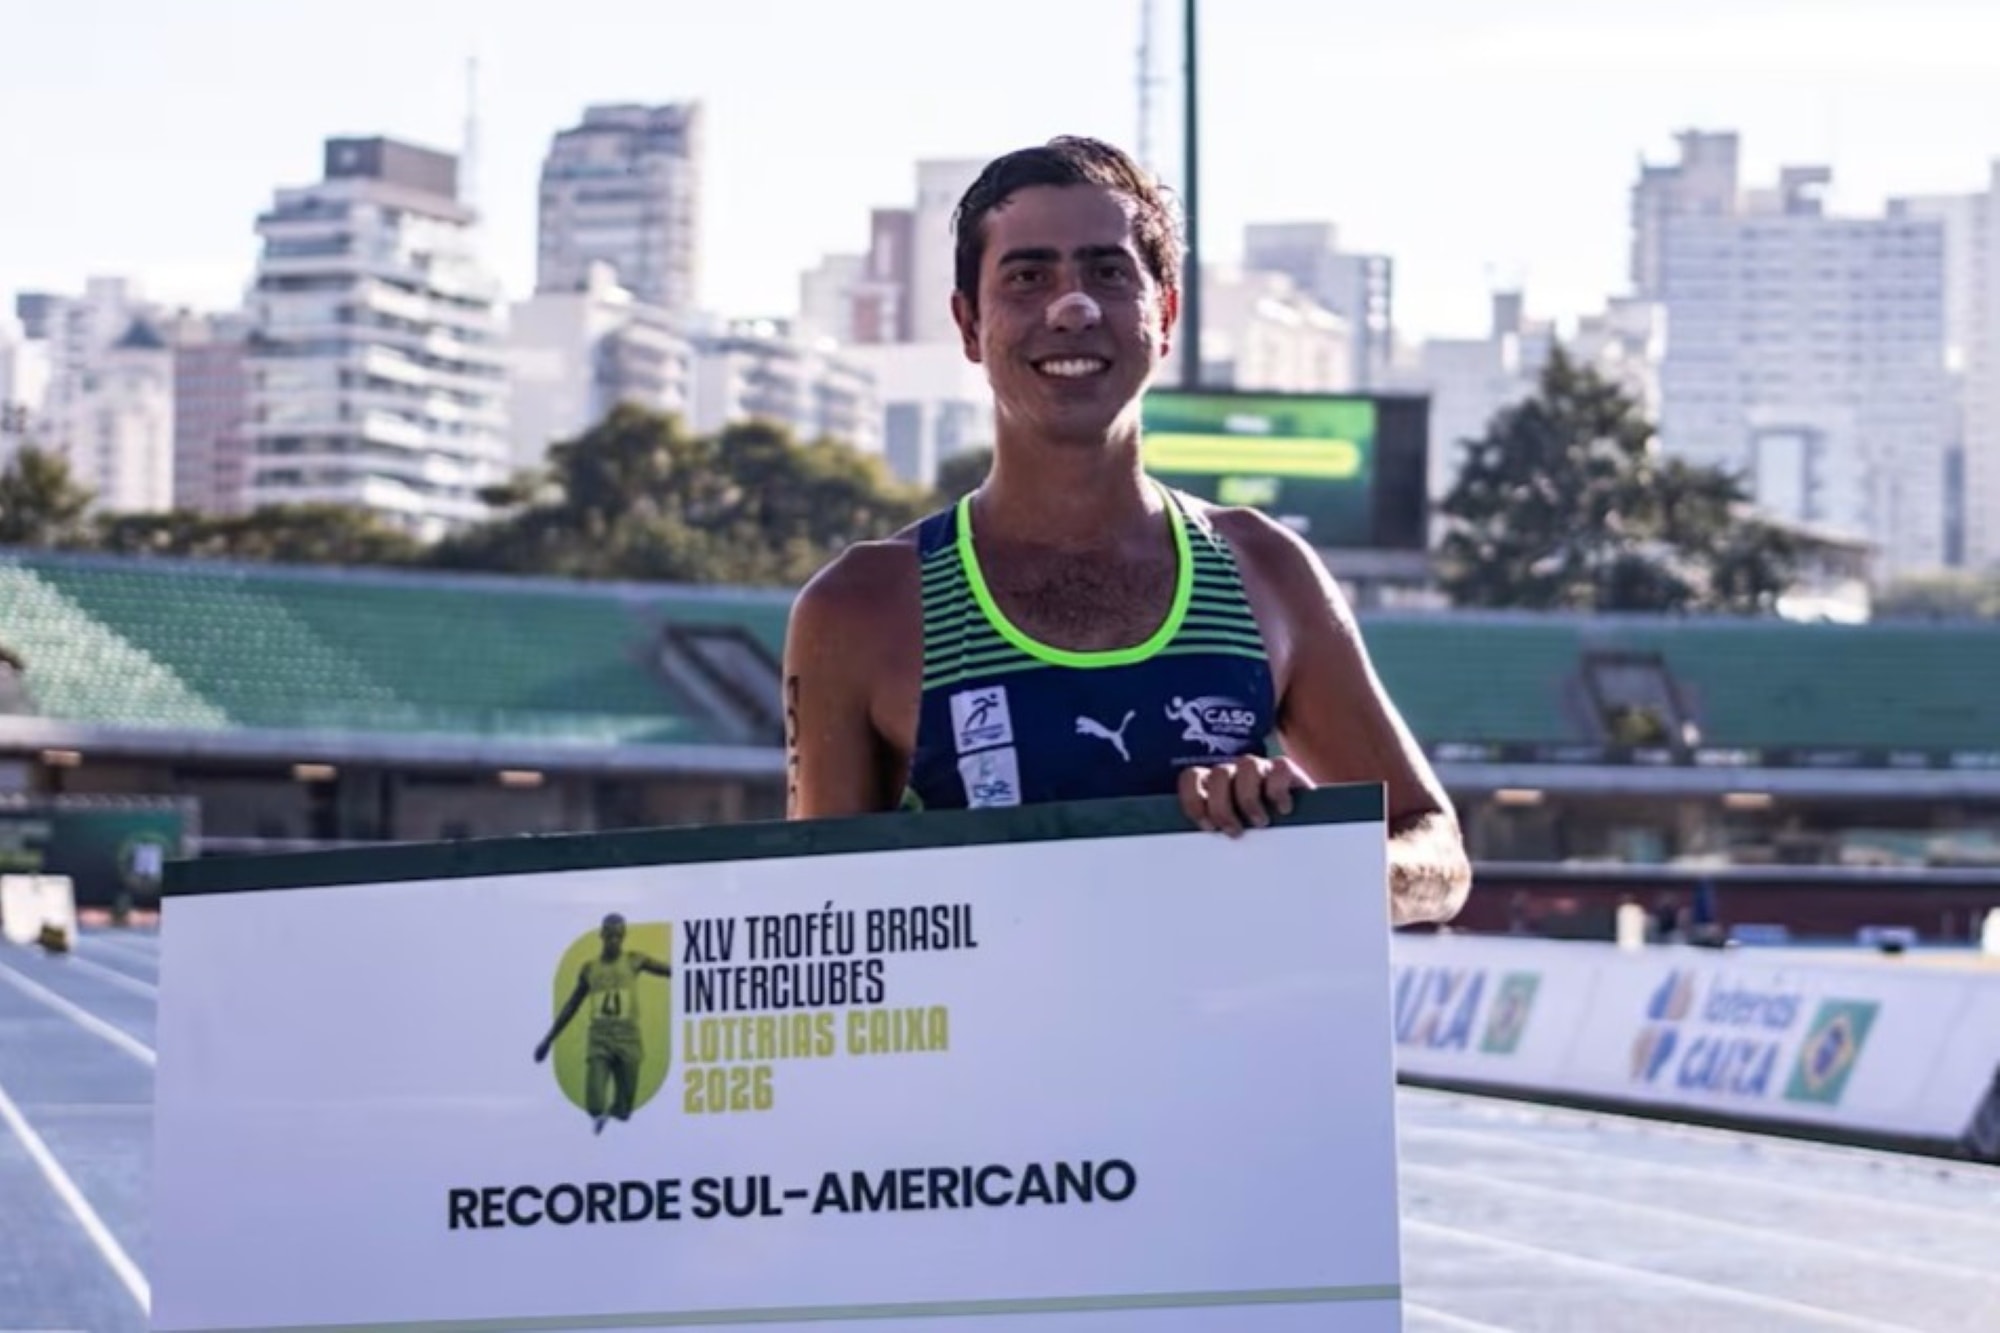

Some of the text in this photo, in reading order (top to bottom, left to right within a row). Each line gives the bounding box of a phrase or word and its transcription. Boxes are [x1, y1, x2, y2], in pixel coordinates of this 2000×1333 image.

[683, 900, 978, 964] XLV TROFÉU BRASIL
[684, 958, 885, 1014] INTERCLUBES
[683, 1005, 949, 1064] LOTERIAS CAIXA
[683, 1065, 774, 1115] 2026
[1677, 1035, 1780, 1096] CAIXA
[448, 1159, 1137, 1230] RECORDE SUL-AMERICANO
